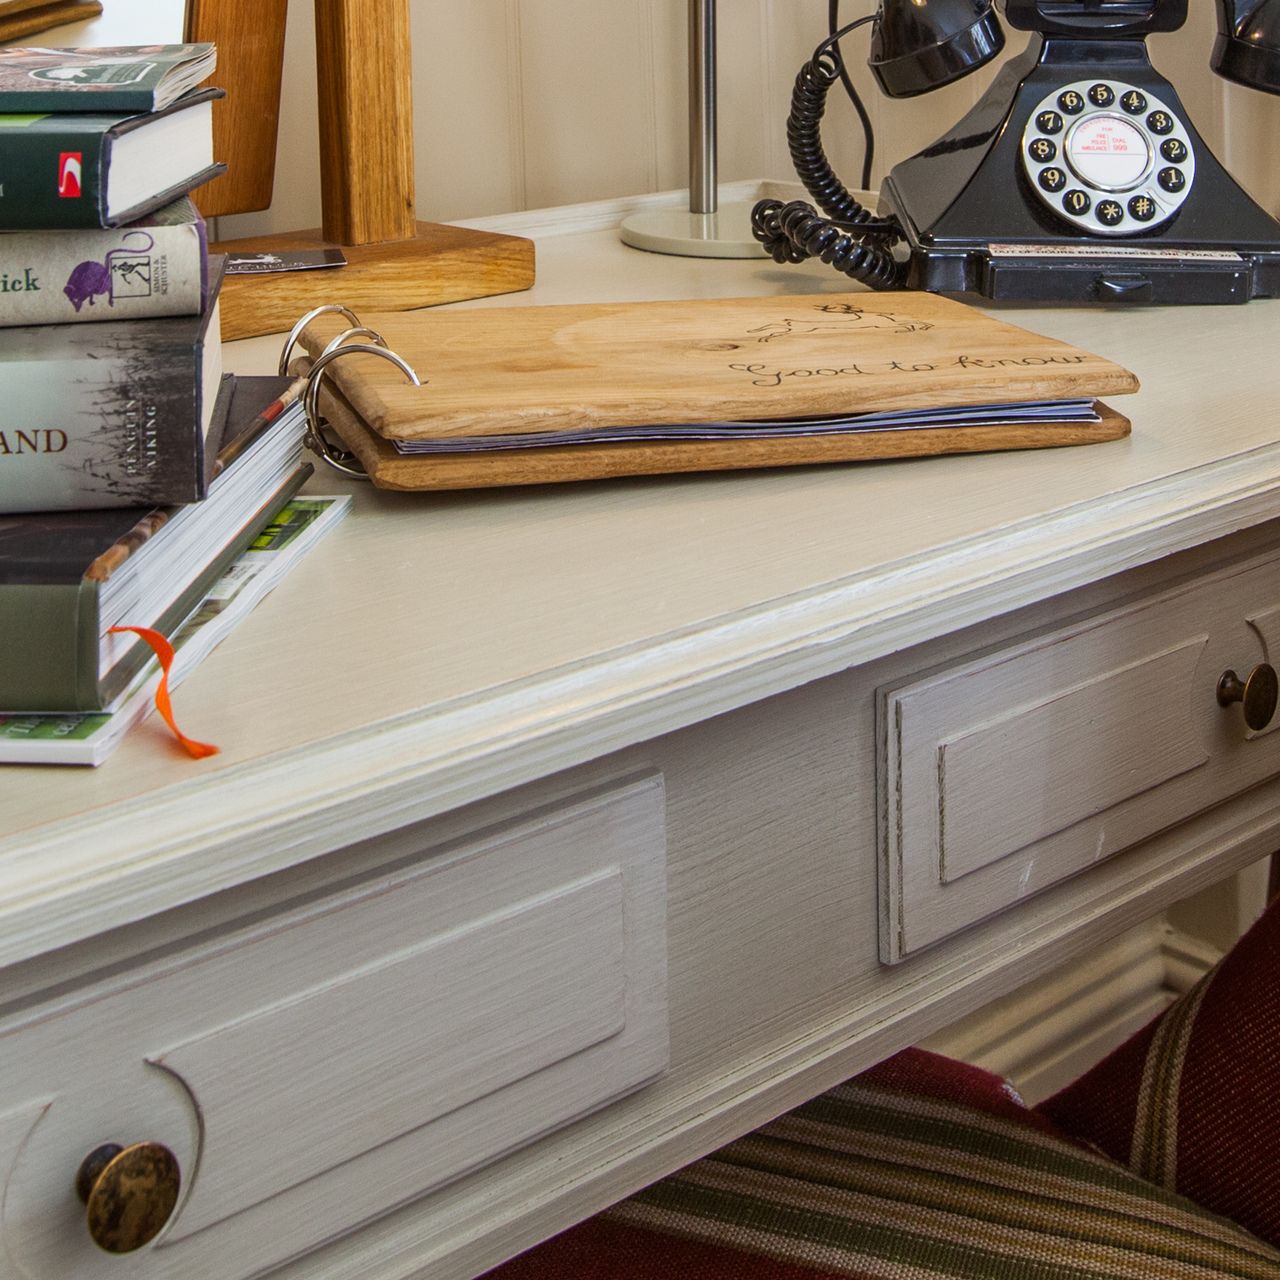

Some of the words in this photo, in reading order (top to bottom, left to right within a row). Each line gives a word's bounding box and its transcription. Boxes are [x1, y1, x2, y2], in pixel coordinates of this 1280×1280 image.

[1066, 94, 1077, 107] 6
[1097, 87, 1108, 100] 5
[1128, 92, 1139, 107] 4
[1044, 113, 1055, 128] 7
[1156, 113, 1167, 127] 3
[1037, 141, 1049, 155] 8
[1171, 141, 1182, 155] 2
[1047, 170, 1060, 185] 9
[1169, 169, 1179, 183] 1
[1072, 193, 1085, 208] 0
[729, 363, 874, 387] Good
[886, 360, 936, 373] to
[953, 355, 1088, 370] know
[146, 405, 157, 473] VIKING
